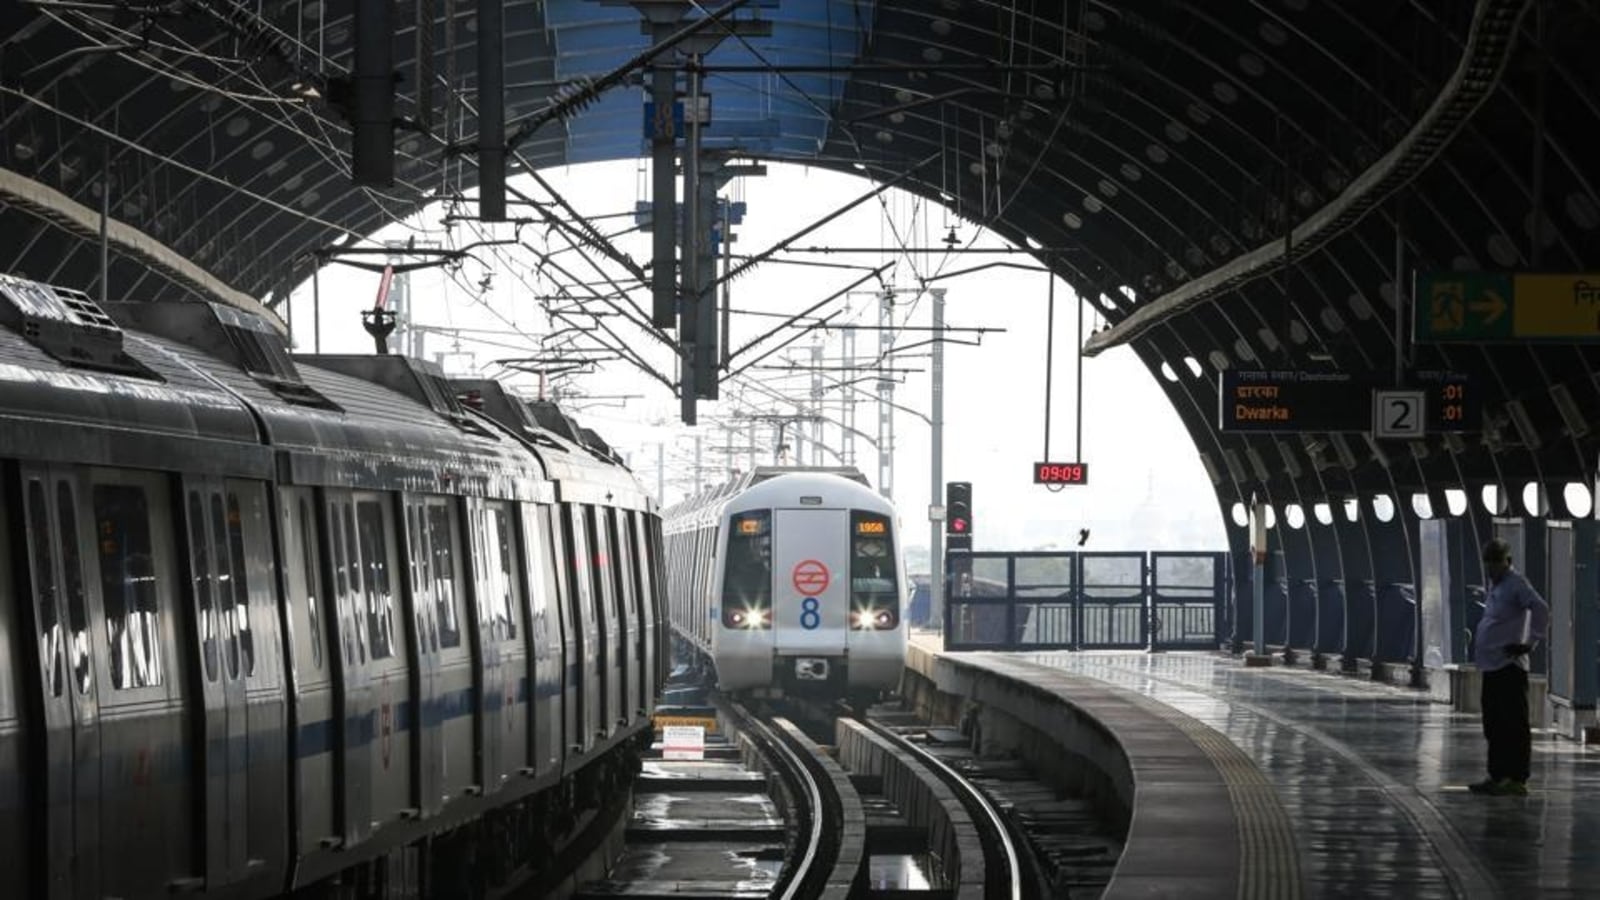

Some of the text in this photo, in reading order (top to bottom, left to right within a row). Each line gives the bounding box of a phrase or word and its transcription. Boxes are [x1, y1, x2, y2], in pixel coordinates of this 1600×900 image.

[1573, 279, 1600, 305] नि
[1235, 403, 1289, 420] Dwarka
[1390, 400, 1412, 429] 2
[1040, 465, 1081, 481] 09:09
[800, 597, 821, 631] 8
